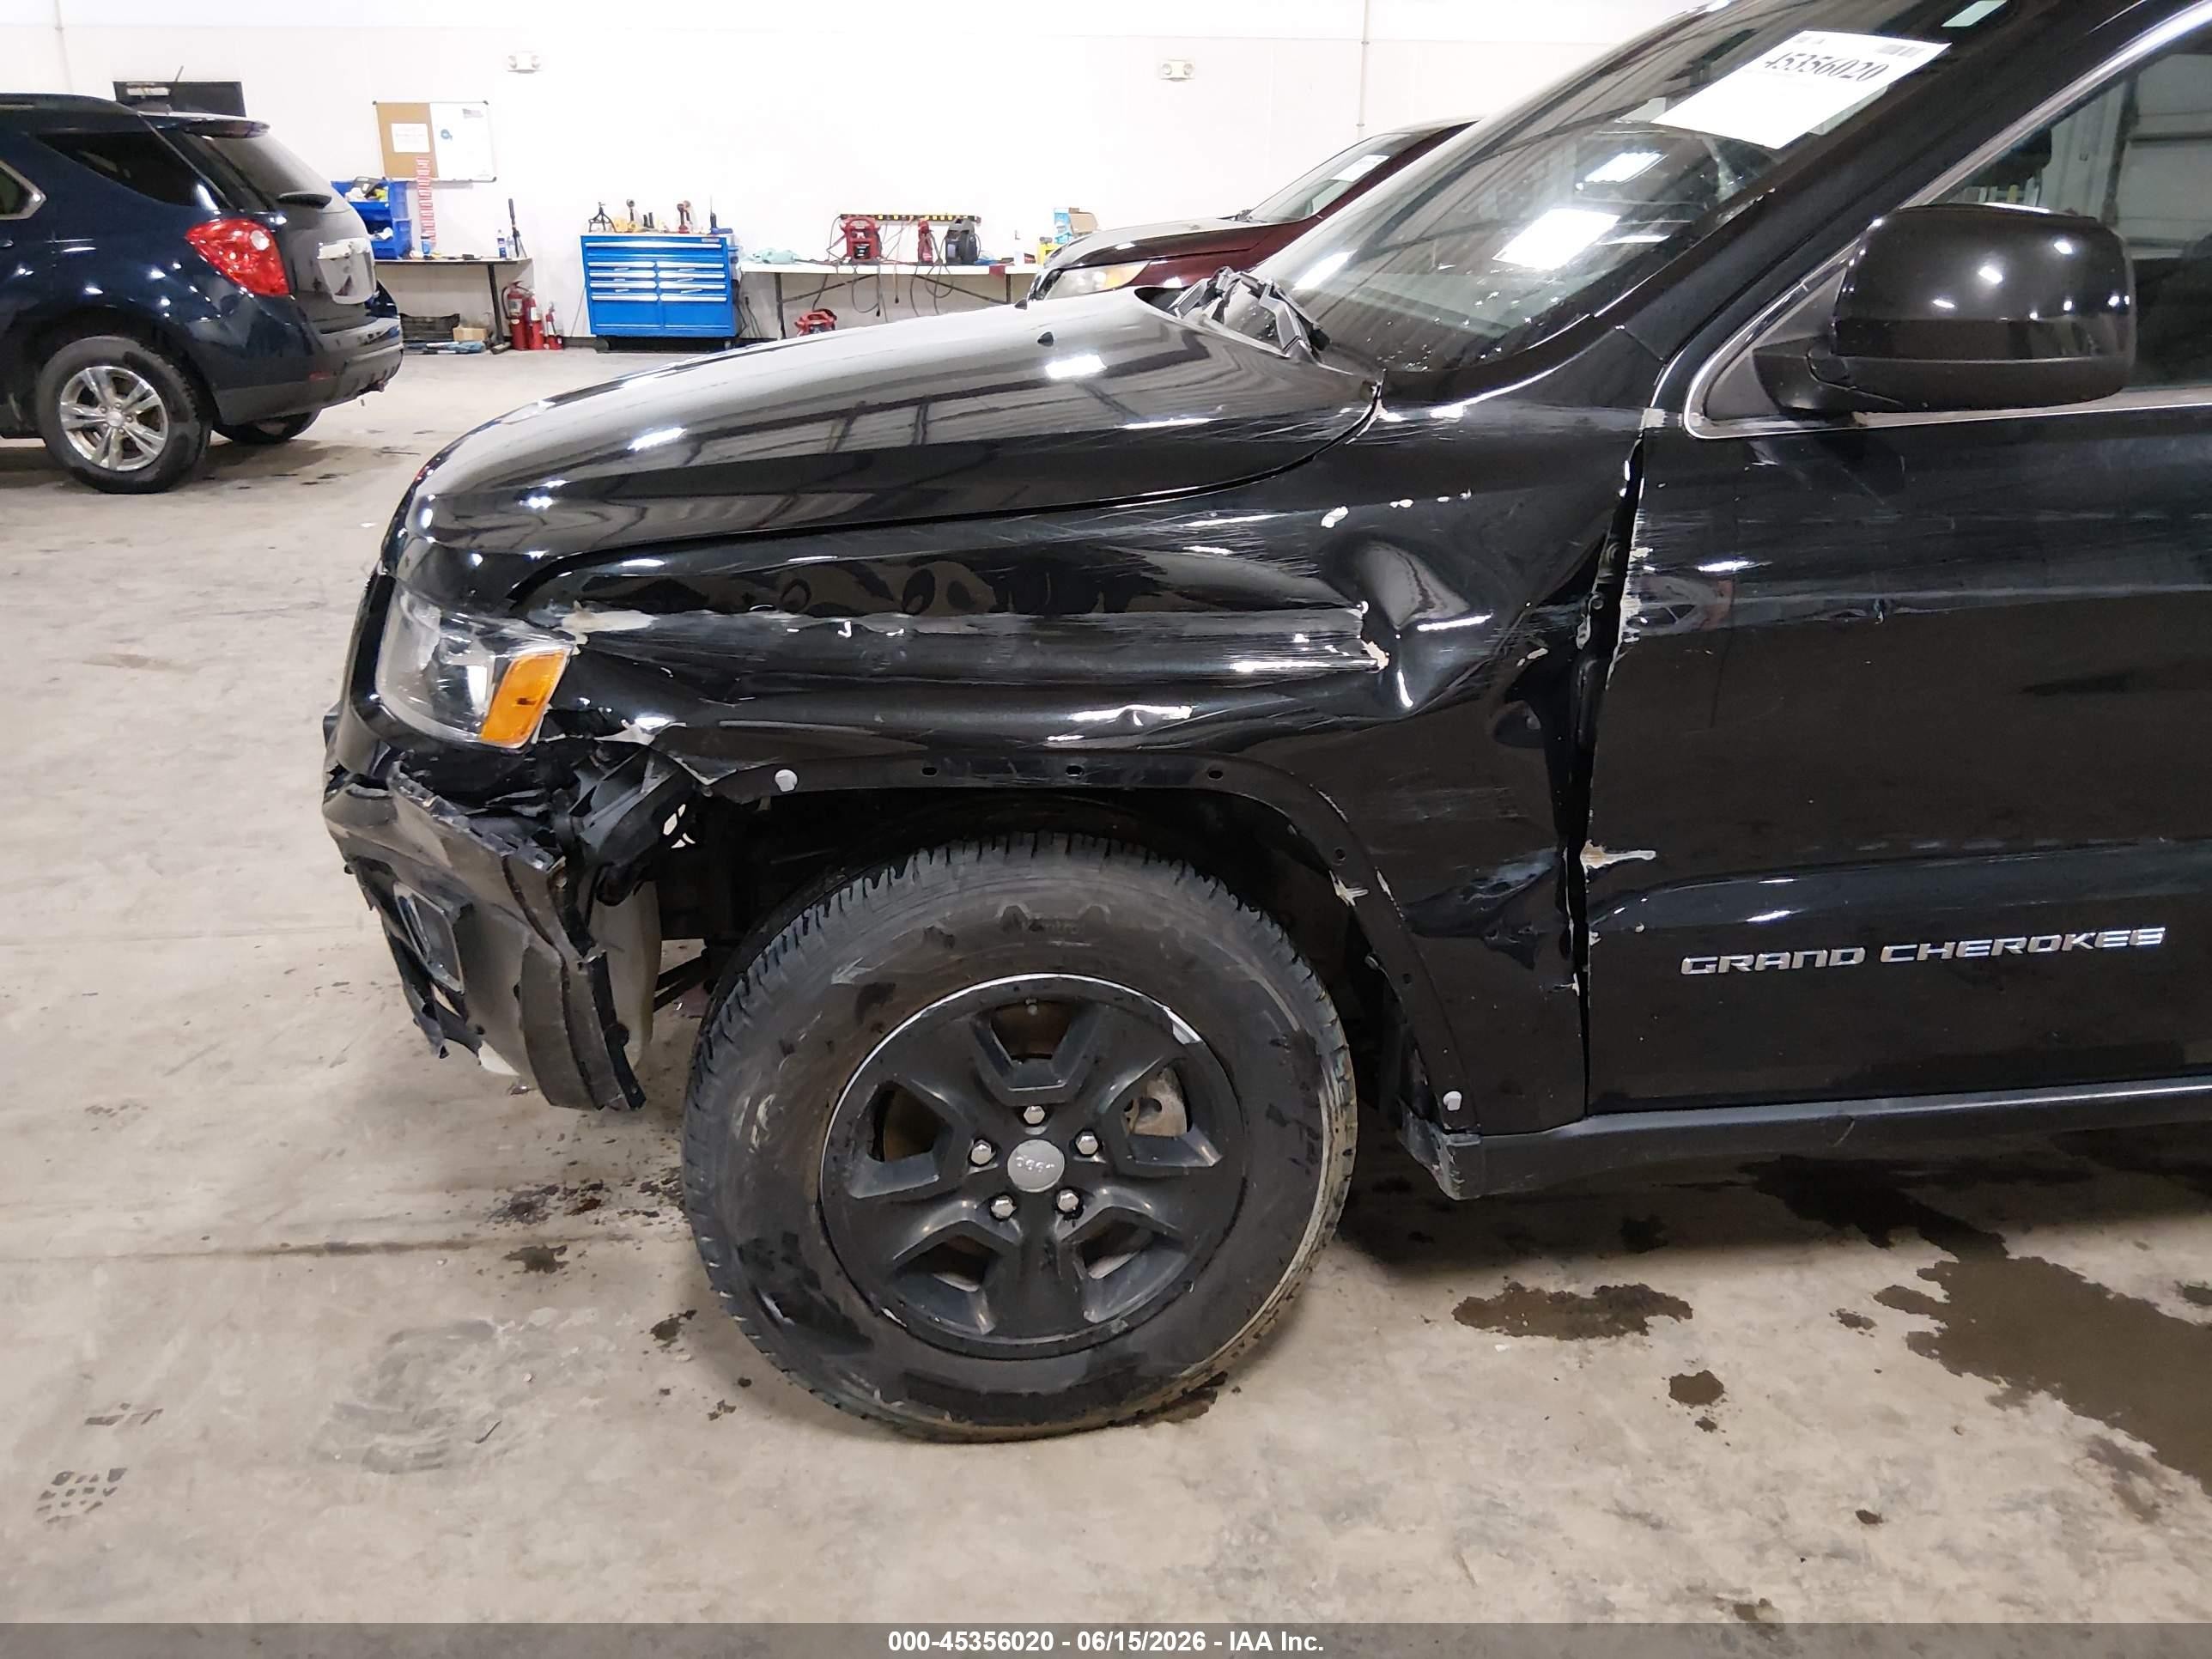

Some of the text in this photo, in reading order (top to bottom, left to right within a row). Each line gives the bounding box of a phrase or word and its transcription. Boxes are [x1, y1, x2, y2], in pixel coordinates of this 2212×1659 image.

[1765, 52, 1890, 82] 45356020
[1680, 927, 2166, 975] GRAND CHEROKEE
